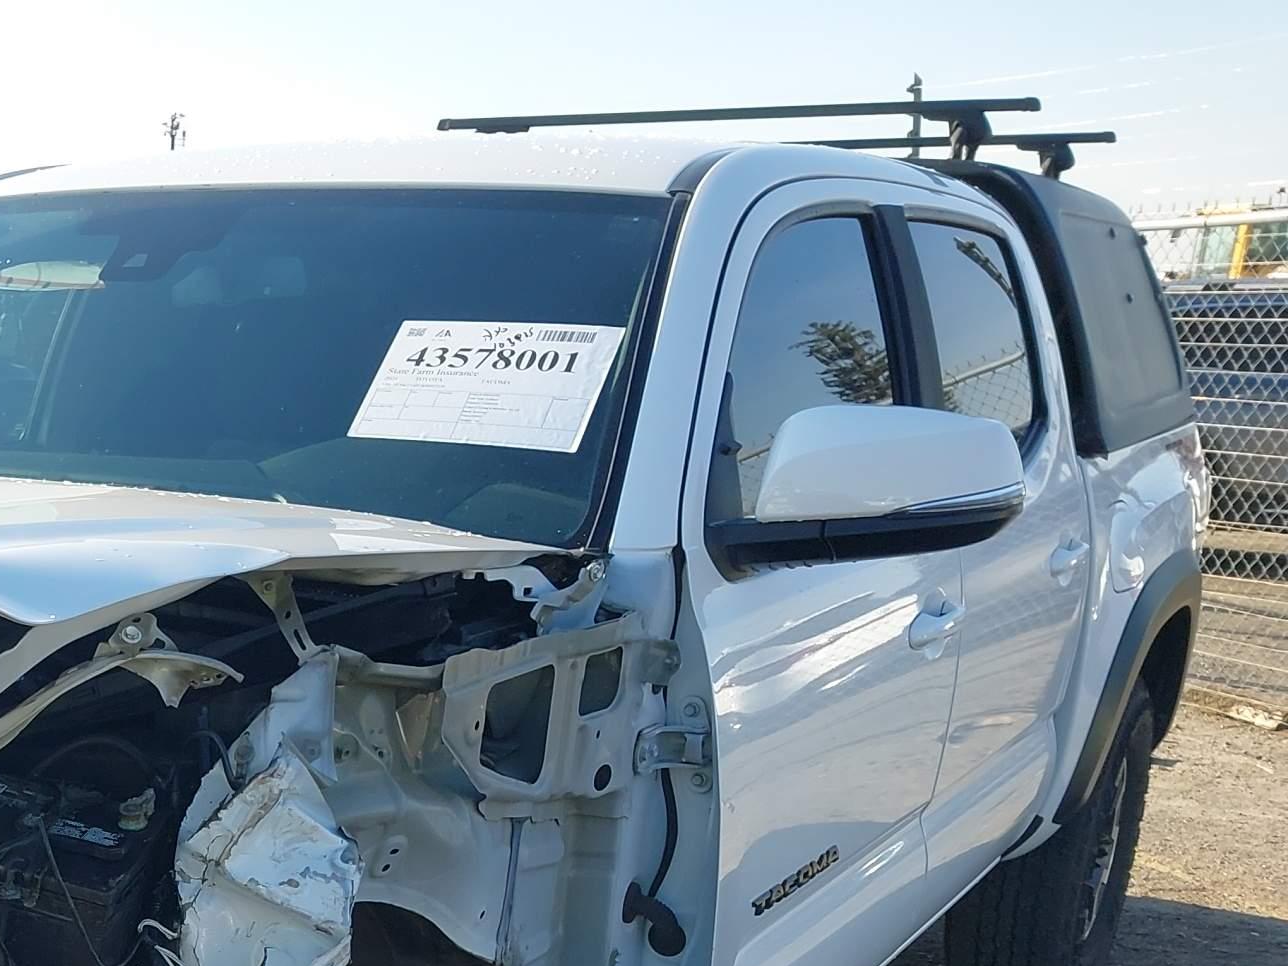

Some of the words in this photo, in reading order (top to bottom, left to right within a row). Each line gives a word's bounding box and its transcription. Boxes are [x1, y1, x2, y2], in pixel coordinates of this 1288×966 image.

[388, 367, 410, 375] State
[411, 368, 435, 376] Farm
[436, 369, 480, 377] Insurance
[406, 347, 579, 374] 43578001
[751, 844, 840, 917] TACOMA
